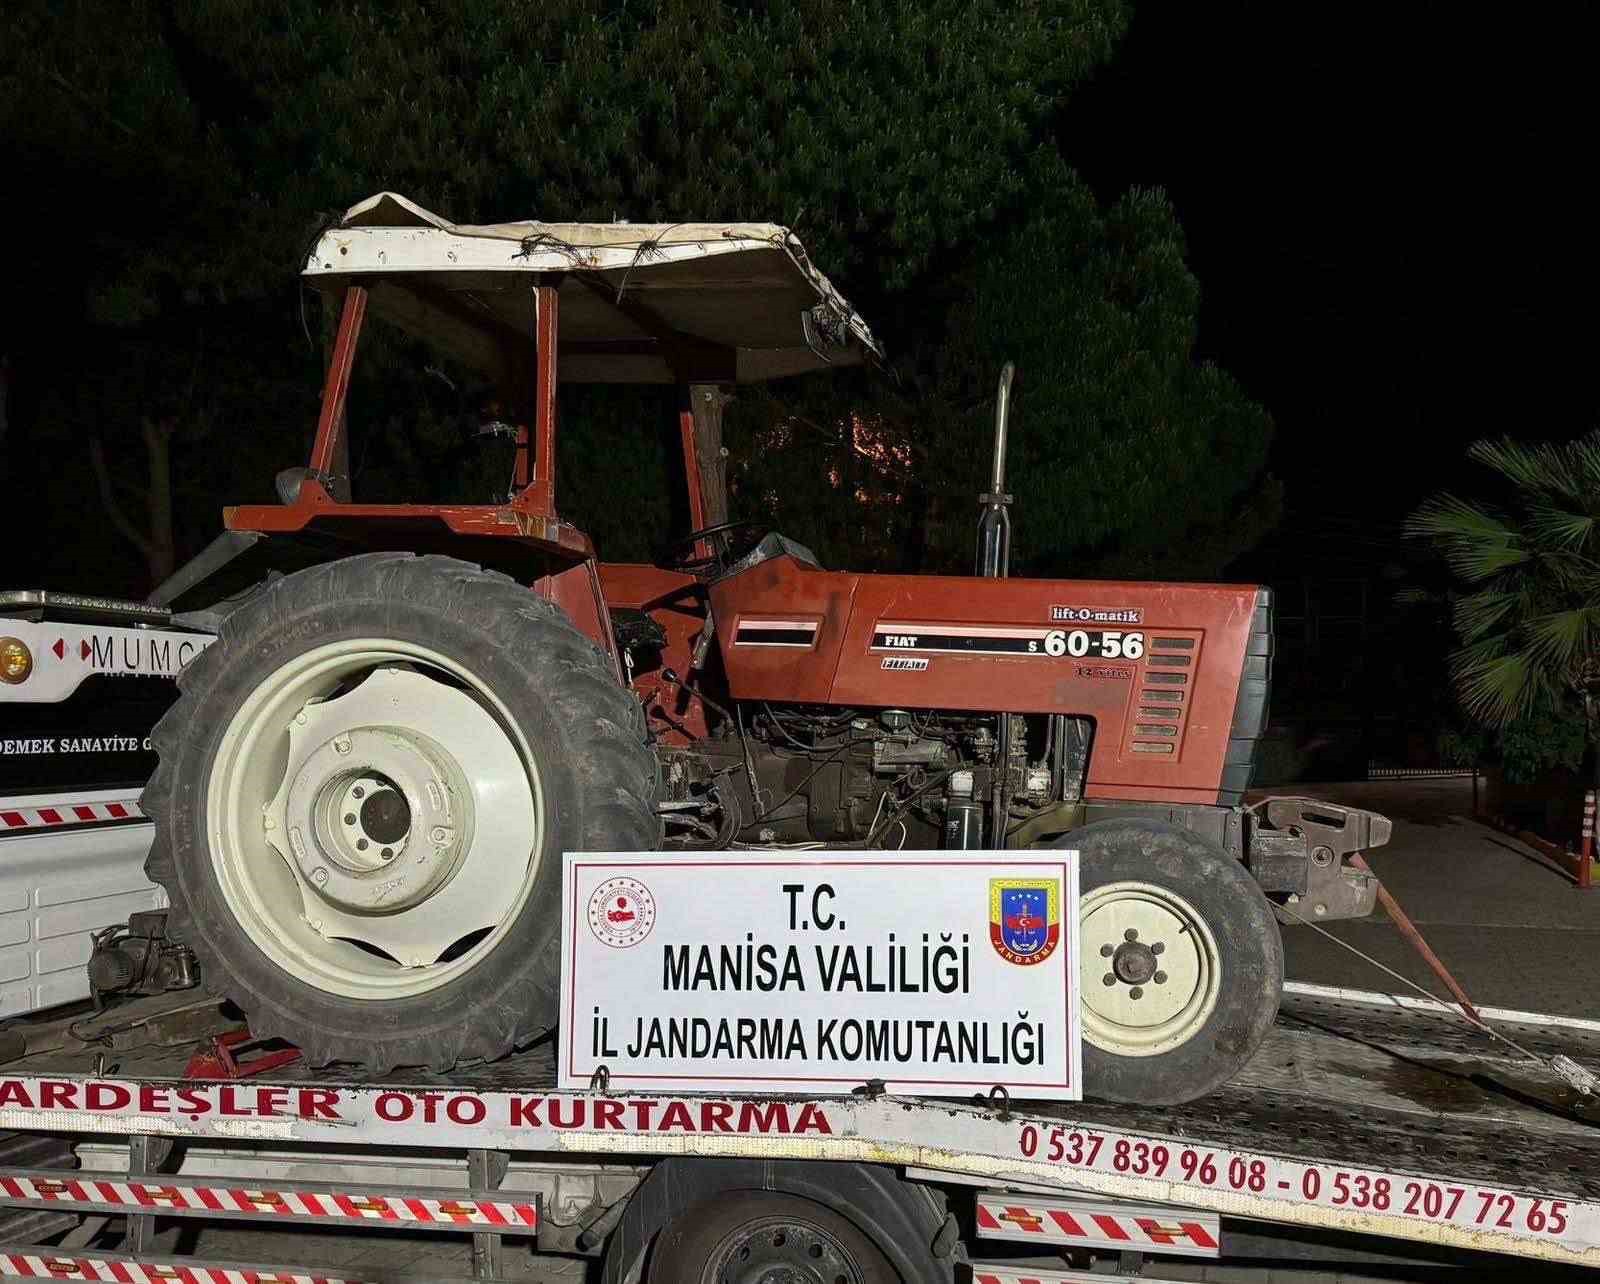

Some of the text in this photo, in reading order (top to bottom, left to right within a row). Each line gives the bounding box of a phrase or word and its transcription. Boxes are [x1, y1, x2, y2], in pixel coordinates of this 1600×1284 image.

[92, 635, 207, 671] MUMC
[885, 635, 918, 648] FIAT
[1044, 630, 1144, 660] 60-56
[60, 734, 138, 753] SANAYİYE
[783, 884, 846, 930] T.C.
[662, 932, 970, 994] MANİSA VALİLİĞİ
[592, 1006, 1045, 1066] İL JANDARMA KOMUTANLIĞI
[0, 1080, 833, 1134] ARDEŞLER OTO KURTARMA
[1020, 1126, 1038, 1157] 0
[1047, 1129, 1105, 1167] 537
[1113, 1140, 1170, 1178] 839
[1180, 1150, 1217, 1185] 96
[1228, 1157, 1266, 1192] 08
[1302, 1168, 1321, 1200] 0
[1331, 1172, 1392, 1211] 538
[1403, 1182, 1466, 1219] 207
[1475, 1191, 1516, 1228] 72
[1526, 1198, 1568, 1234] 65
